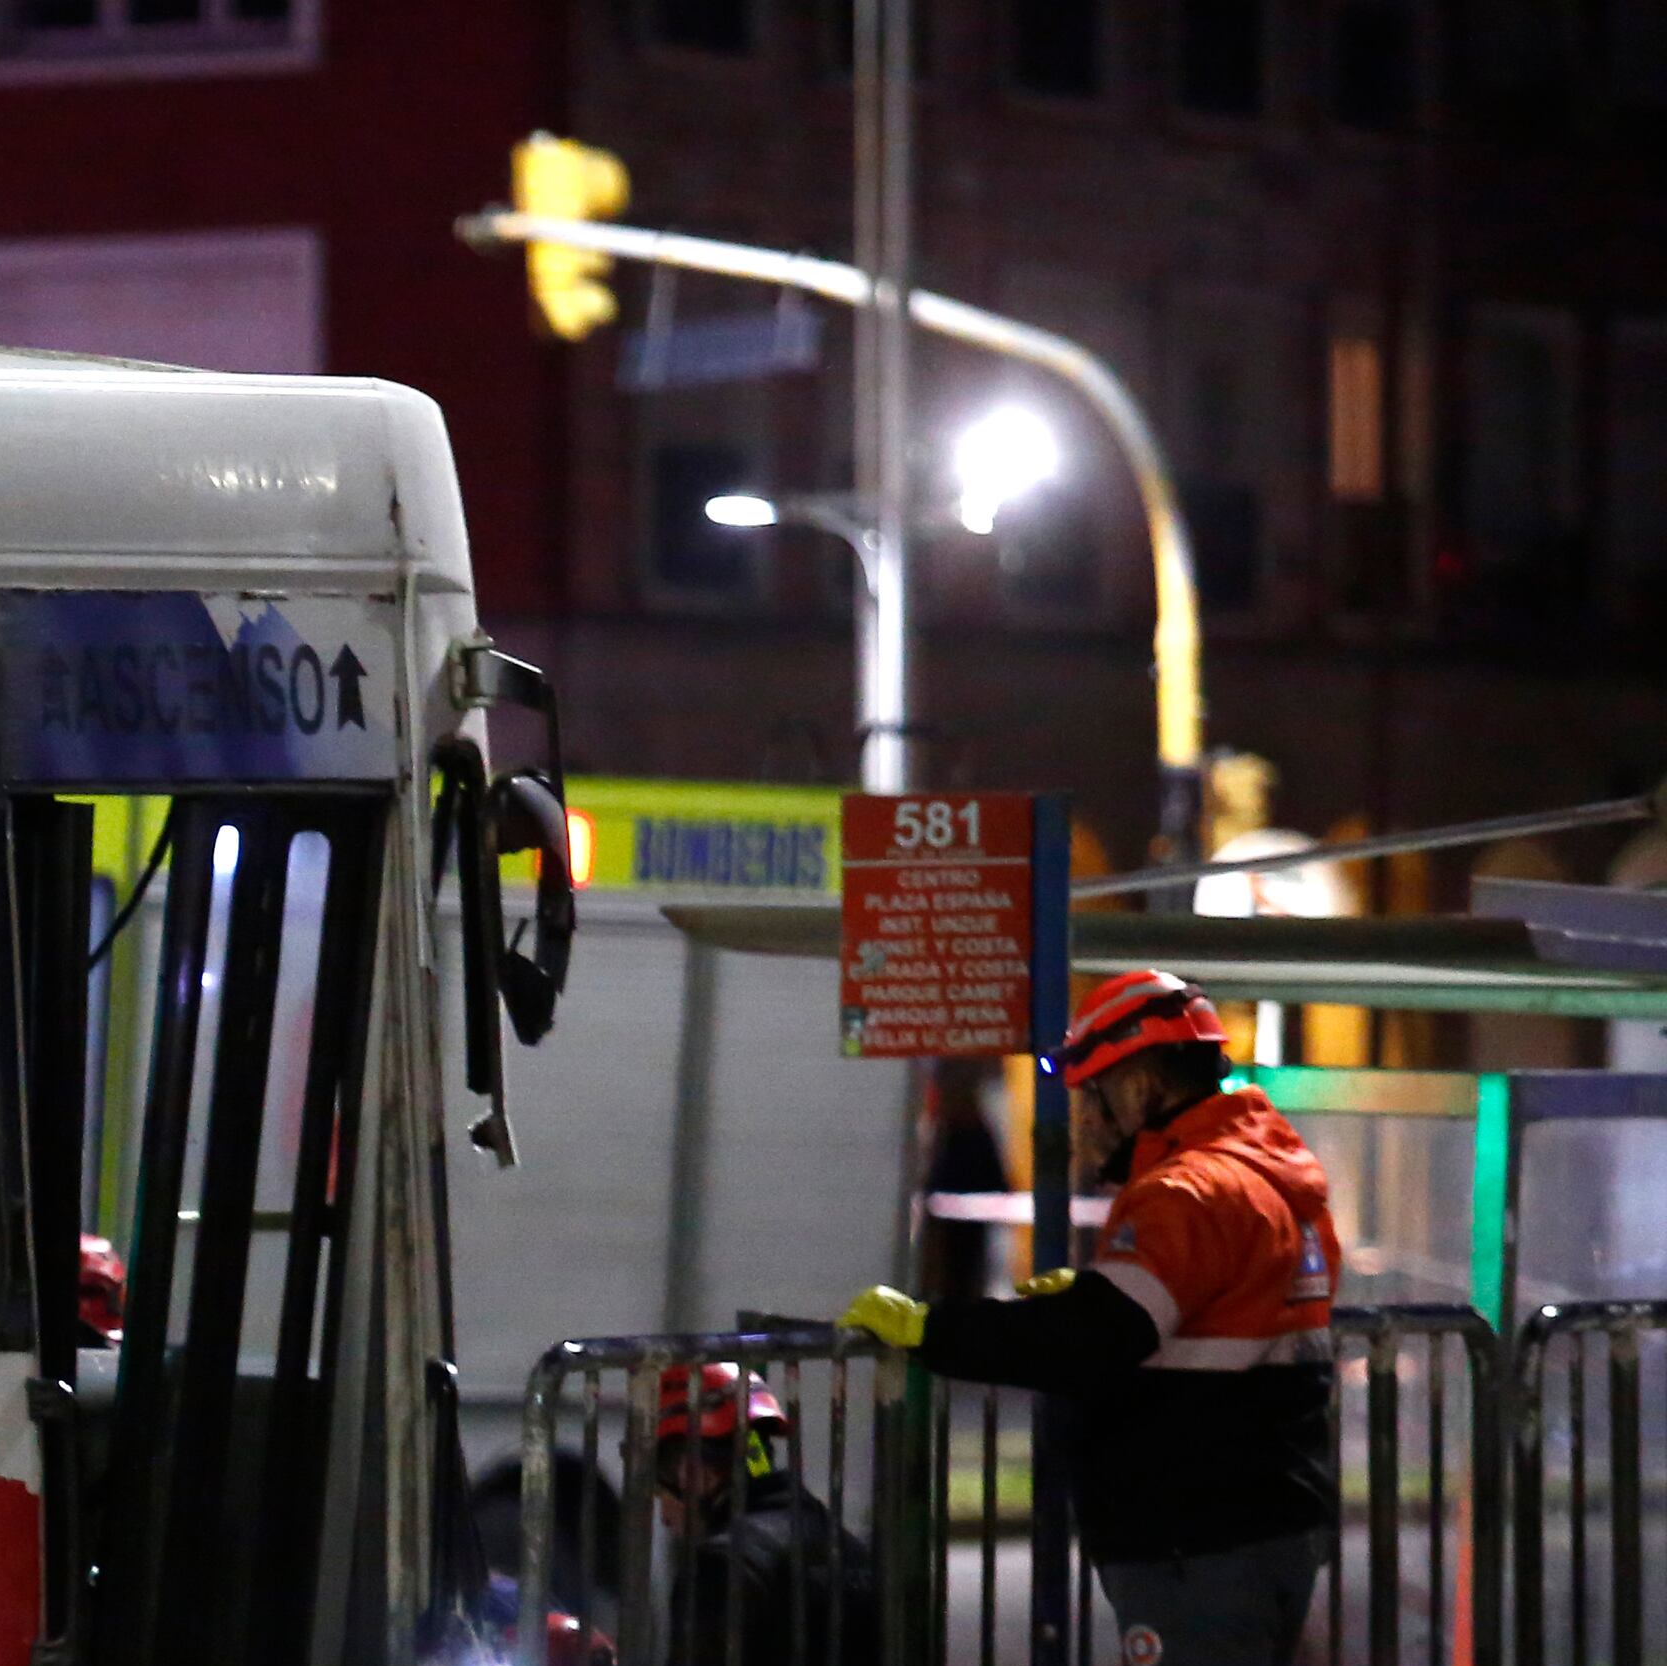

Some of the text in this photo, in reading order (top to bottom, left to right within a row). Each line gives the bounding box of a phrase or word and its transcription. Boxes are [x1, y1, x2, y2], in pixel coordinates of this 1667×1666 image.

[76, 643, 327, 735] ASCENSO
[894, 802, 980, 848] 581
[633, 817, 826, 888] BOMBEROS
[898, 870, 982, 889] CENTRO
[864, 895, 929, 912] PLAZA
[952, 937, 1020, 955] COSTA
[963, 959, 1030, 978] COSTA
[861, 985, 941, 1002] PARQUE
